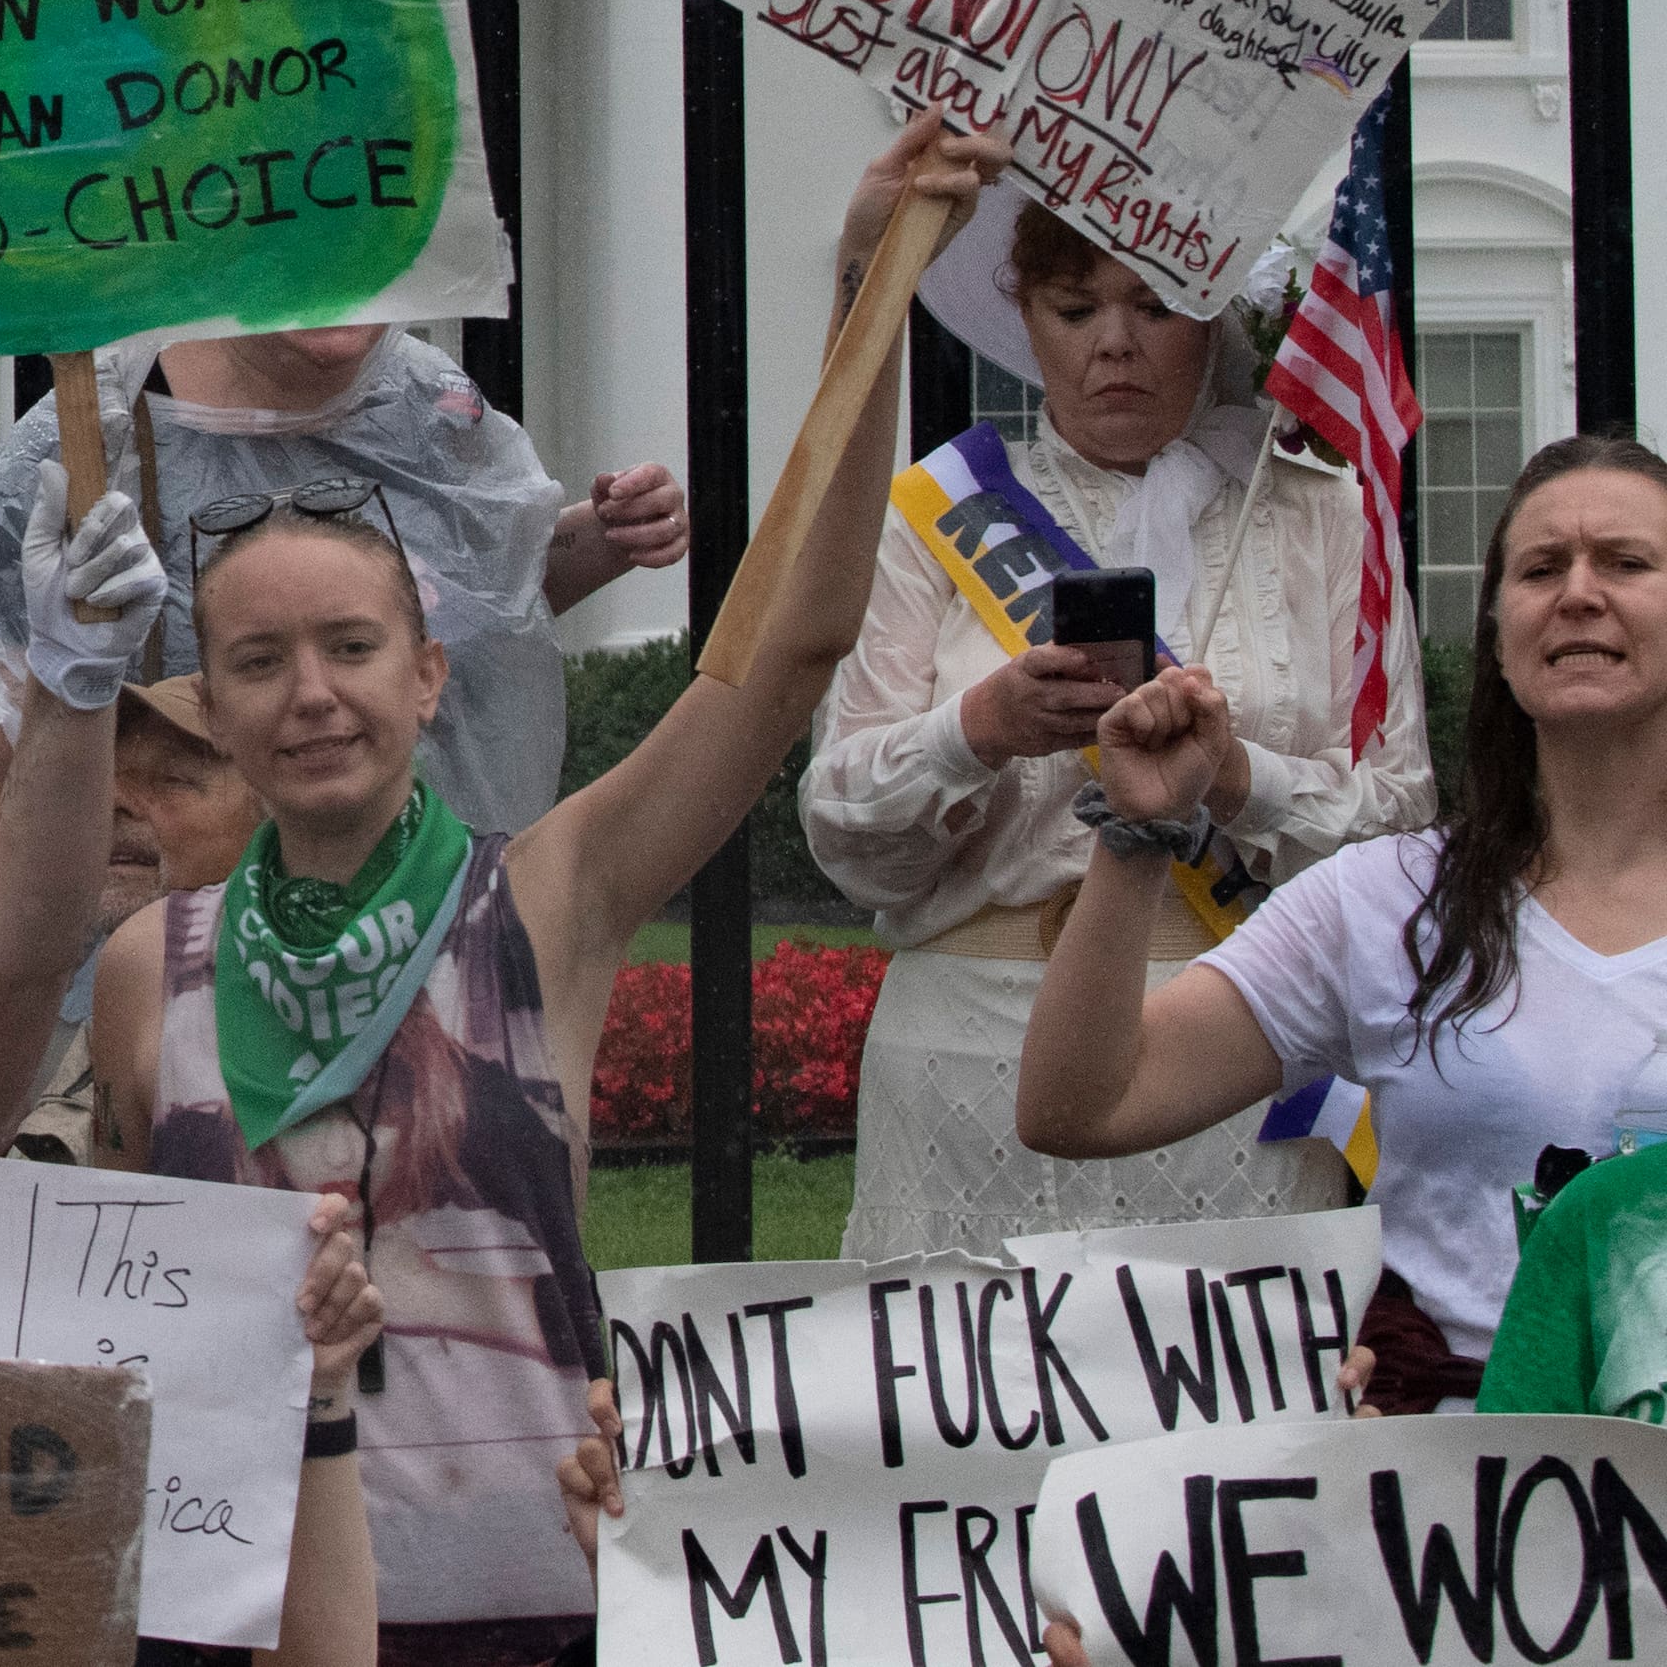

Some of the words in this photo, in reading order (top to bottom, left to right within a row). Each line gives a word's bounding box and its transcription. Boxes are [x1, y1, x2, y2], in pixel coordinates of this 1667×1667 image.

[106, 36, 357, 134] DONOR
[56, 1200, 190, 1307] This
[869, 1267, 1110, 1468] FUCK
[1116, 1264, 1357, 1432] WITH
[682, 1526, 828, 1667] MY
[1076, 1474, 1343, 1667] WE
